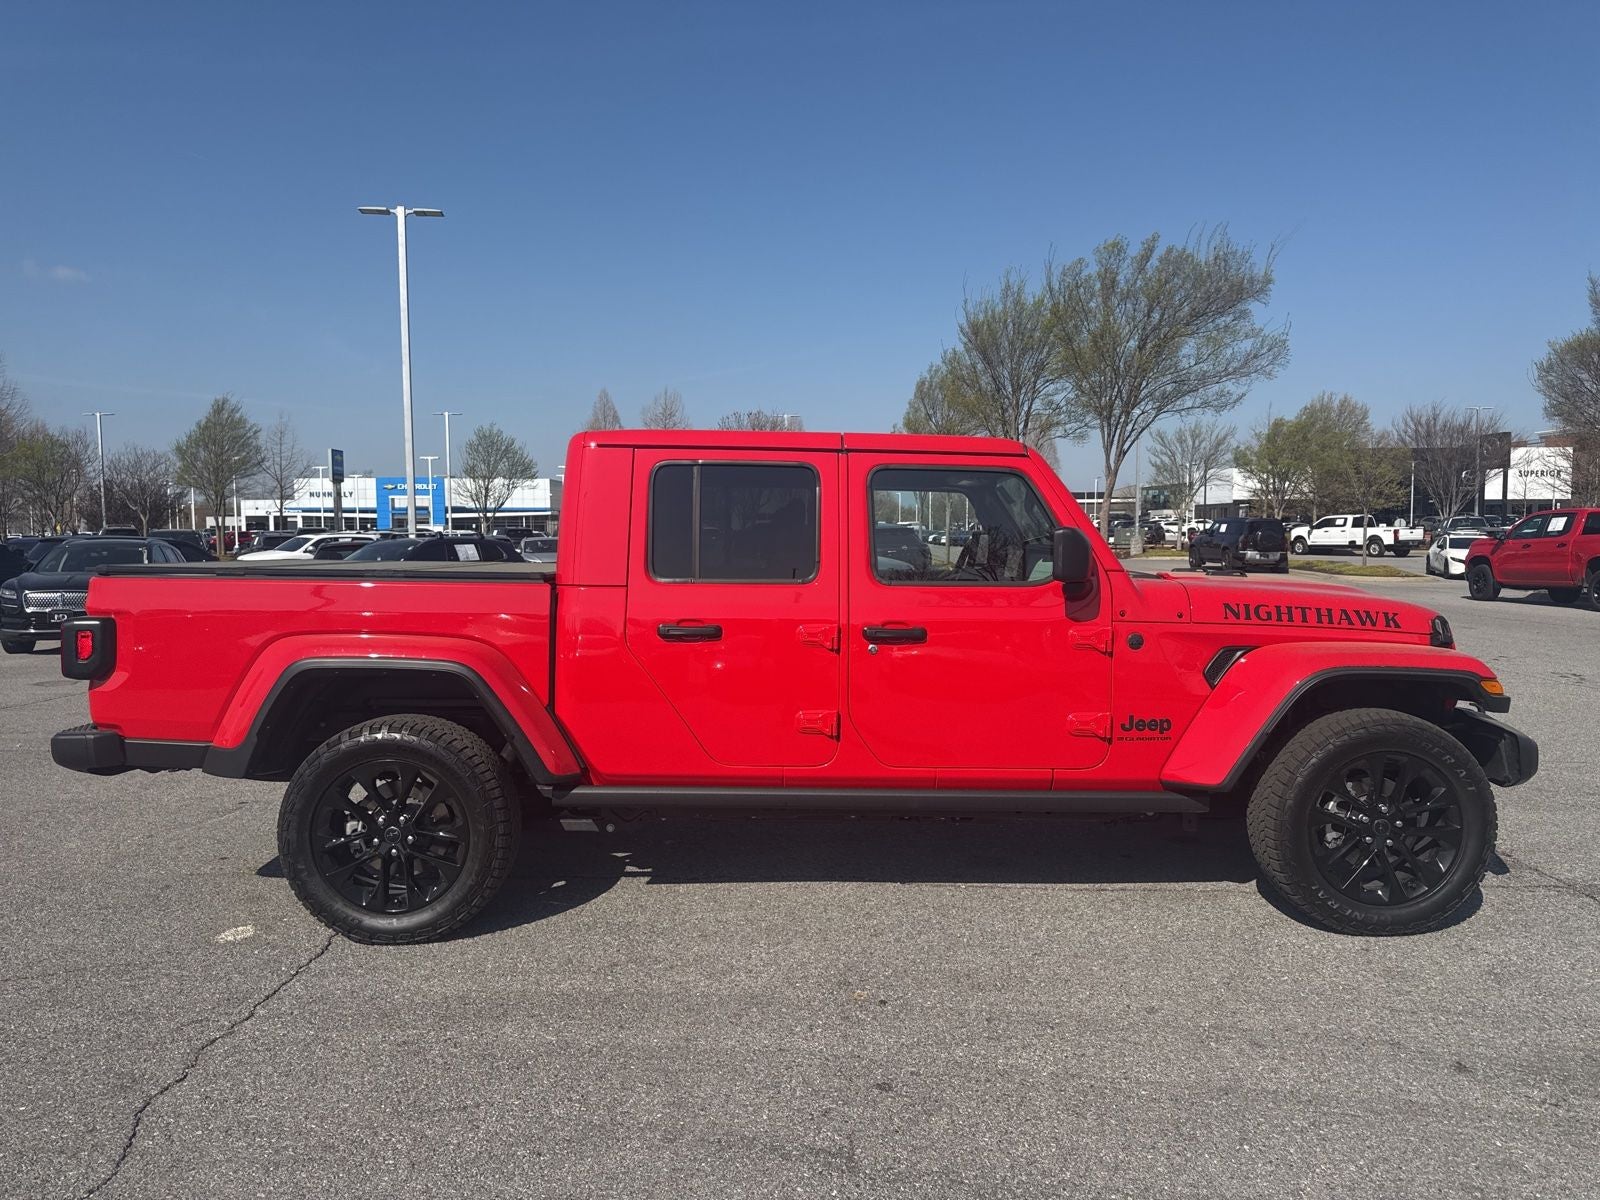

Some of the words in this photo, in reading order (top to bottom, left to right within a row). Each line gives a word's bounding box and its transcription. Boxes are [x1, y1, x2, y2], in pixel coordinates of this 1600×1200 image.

[1518, 469, 1562, 478] SUPERIOR
[1223, 602, 1402, 629] NIGHTHAWK
[1120, 714, 1172, 735] Jeep
